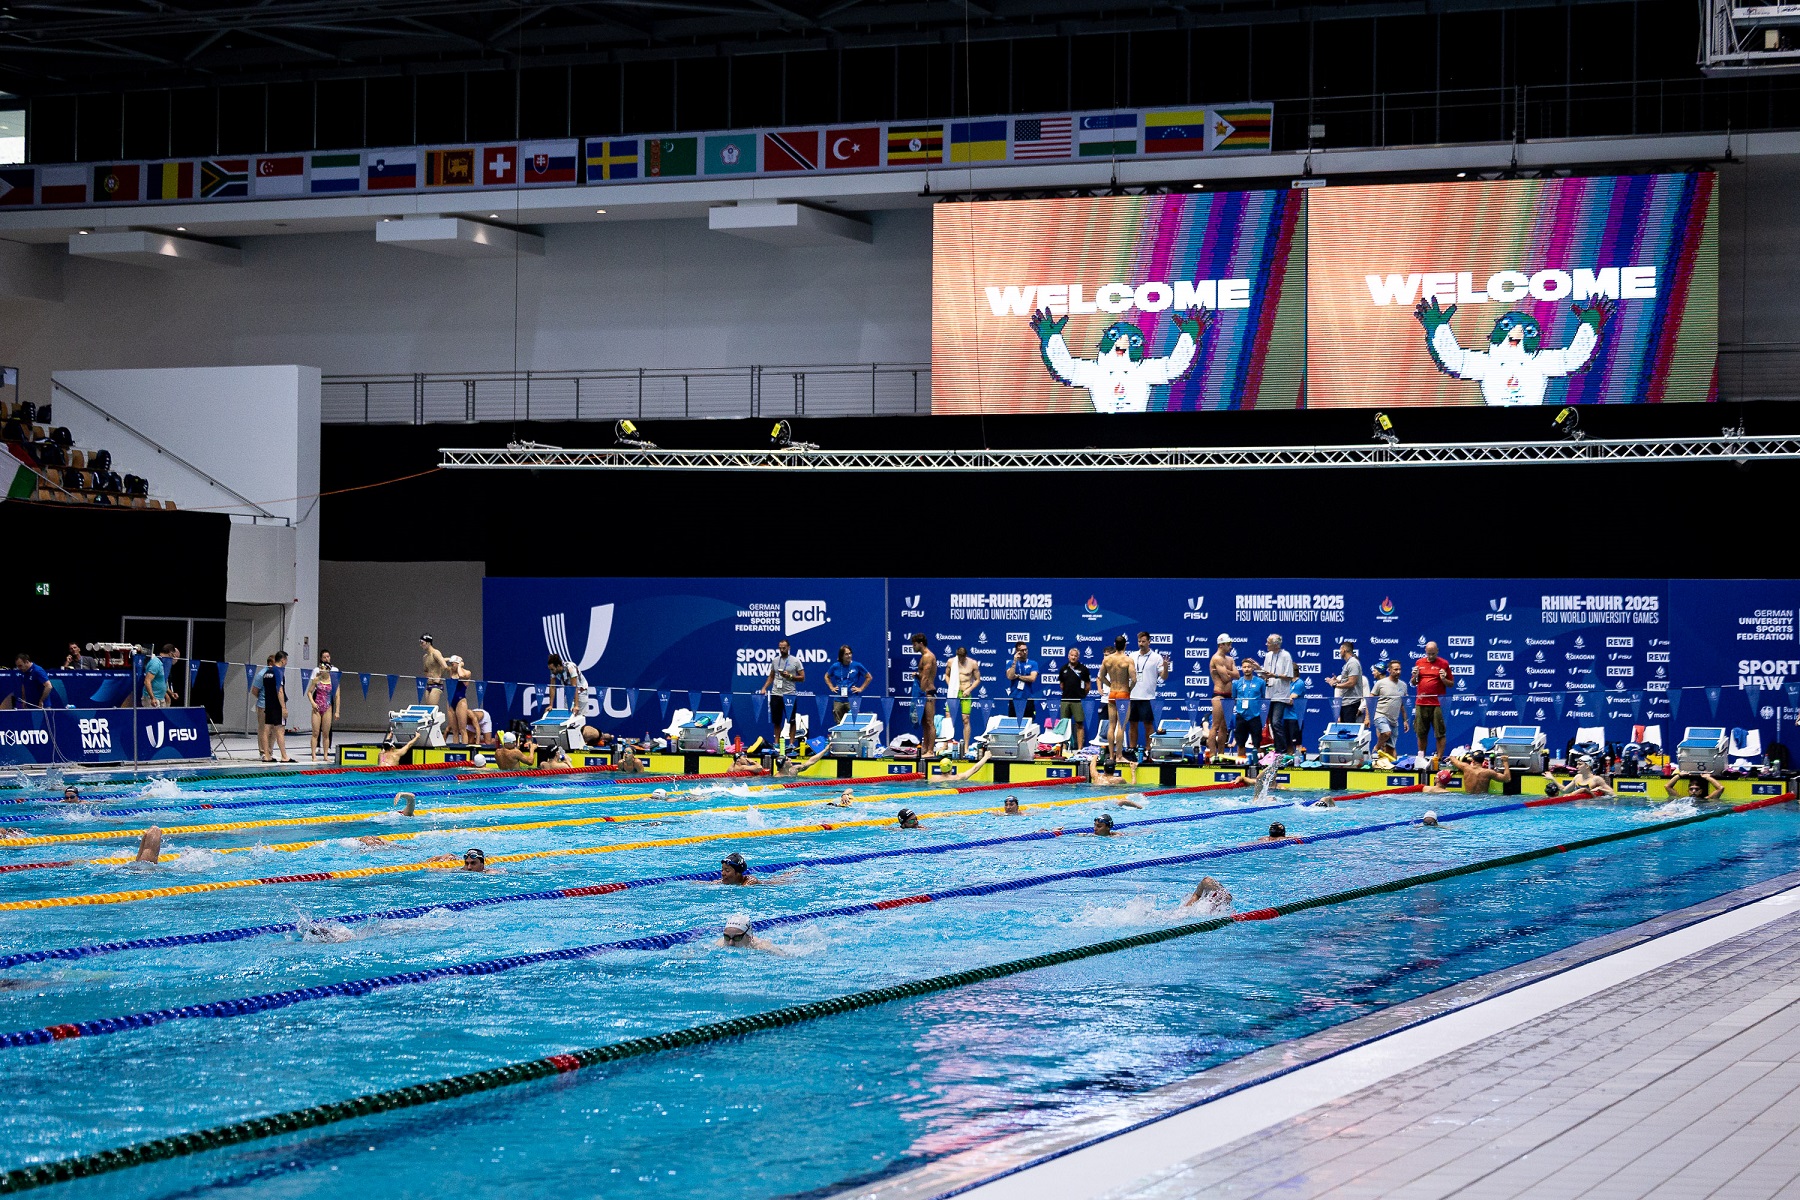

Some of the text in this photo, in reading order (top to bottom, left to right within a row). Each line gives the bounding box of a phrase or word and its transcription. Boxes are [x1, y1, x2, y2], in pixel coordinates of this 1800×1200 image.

[1365, 266, 1657, 306] WELCOME
[985, 278, 1250, 316] WELCOME
[950, 594, 1052, 608] RHINE-RUHR 2025
[1235, 595, 1344, 609] RHINE-RUHR 2025
[1541, 595, 1659, 610] RHINE-RUHR 2025
[792, 605, 831, 622] adh.
[901, 610, 924, 618] FISU
[951, 609, 1052, 620] FISU WORLD UNIVERSITY GAMES
[1236, 610, 1344, 622] FISU WORLD UNIVERSITY GAMES
[1485, 613, 1512, 621] FISU
[1542, 611, 1659, 624] FISU WORLD UNIVERSITY GAMES
[1754, 609, 1793, 617] GERMAN
[1738, 617, 1793, 625] UNIVERSITY
[736, 649, 831, 663] SPORAND.
[78, 718, 109, 734] BOR
[81, 733, 111, 748] NAN
[169, 728, 197, 741] FISU
[1697, 762, 1705, 771] 8
